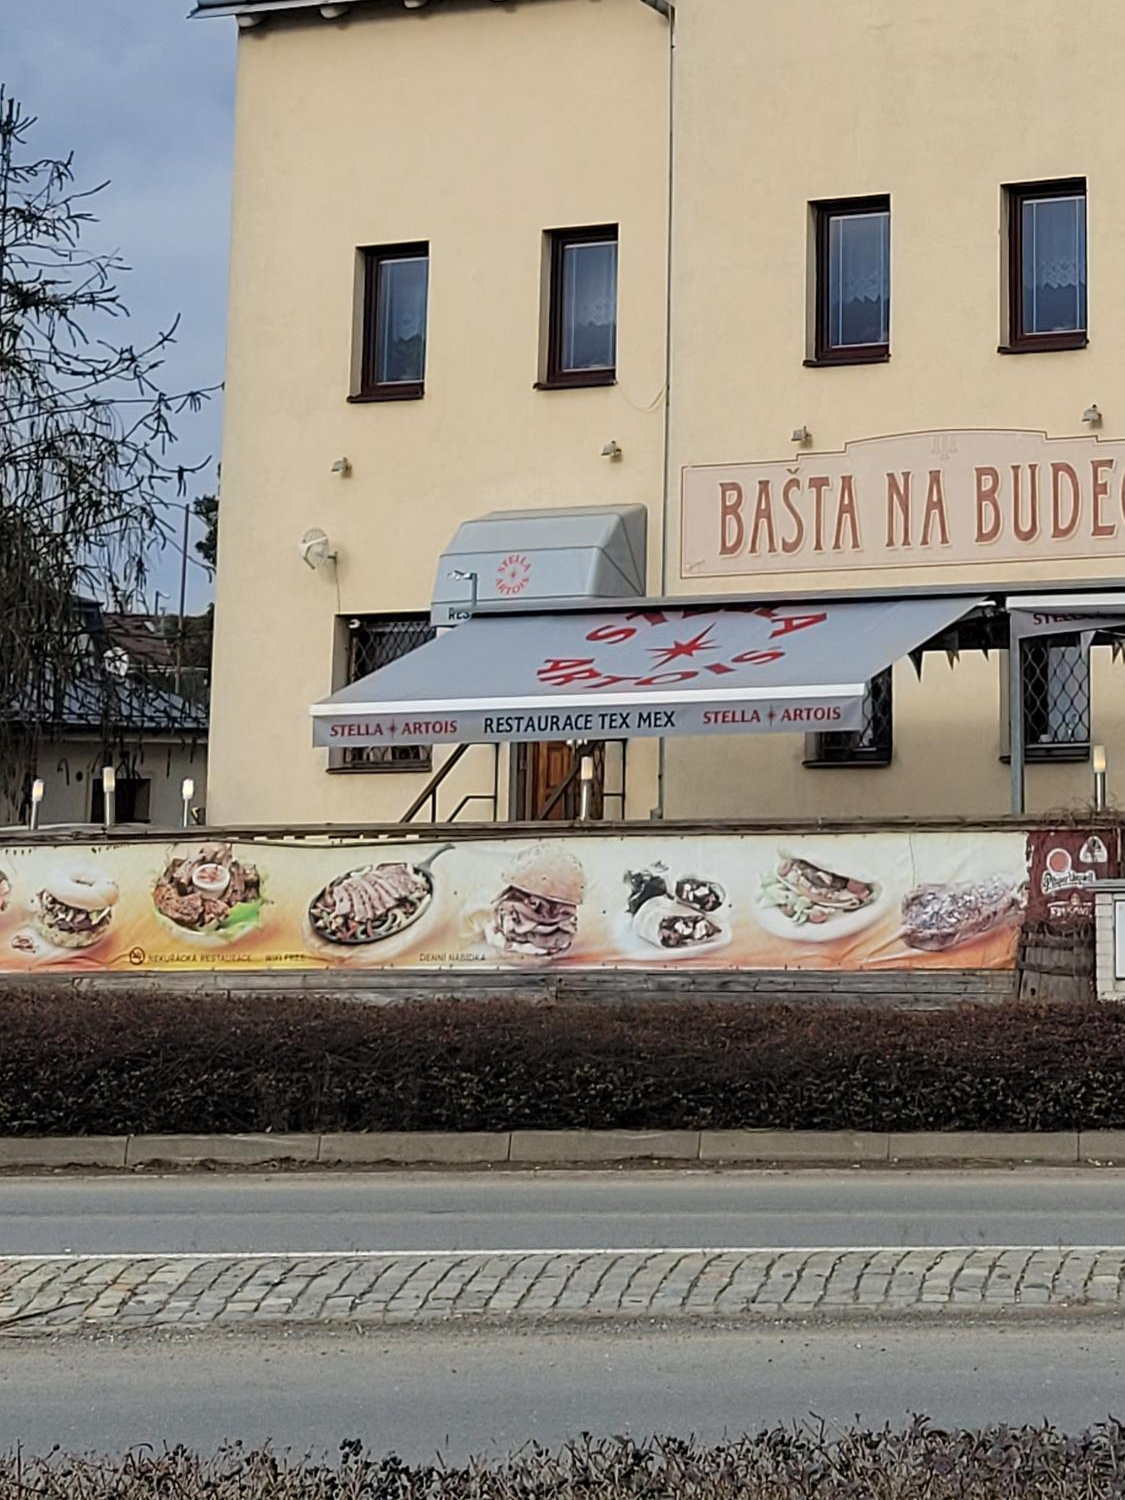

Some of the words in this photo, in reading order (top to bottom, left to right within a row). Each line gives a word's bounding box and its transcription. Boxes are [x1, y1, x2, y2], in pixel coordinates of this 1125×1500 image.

[718, 467, 863, 557] BAŠTA
[885, 469, 951, 548] NA
[497, 553, 532, 573] STELLA
[495, 576, 530, 596] ARTOIS
[536, 646, 786, 689] ARTOIS
[329, 723, 384, 738] STELLA
[401, 720, 459, 737] ARTOIS
[483, 713, 594, 734] RESTAURACE
[598, 712, 632, 730] TEX
[636, 709, 677, 729] MEX
[702, 709, 761, 725] STELLA
[780, 706, 842, 723] ARTOIS
